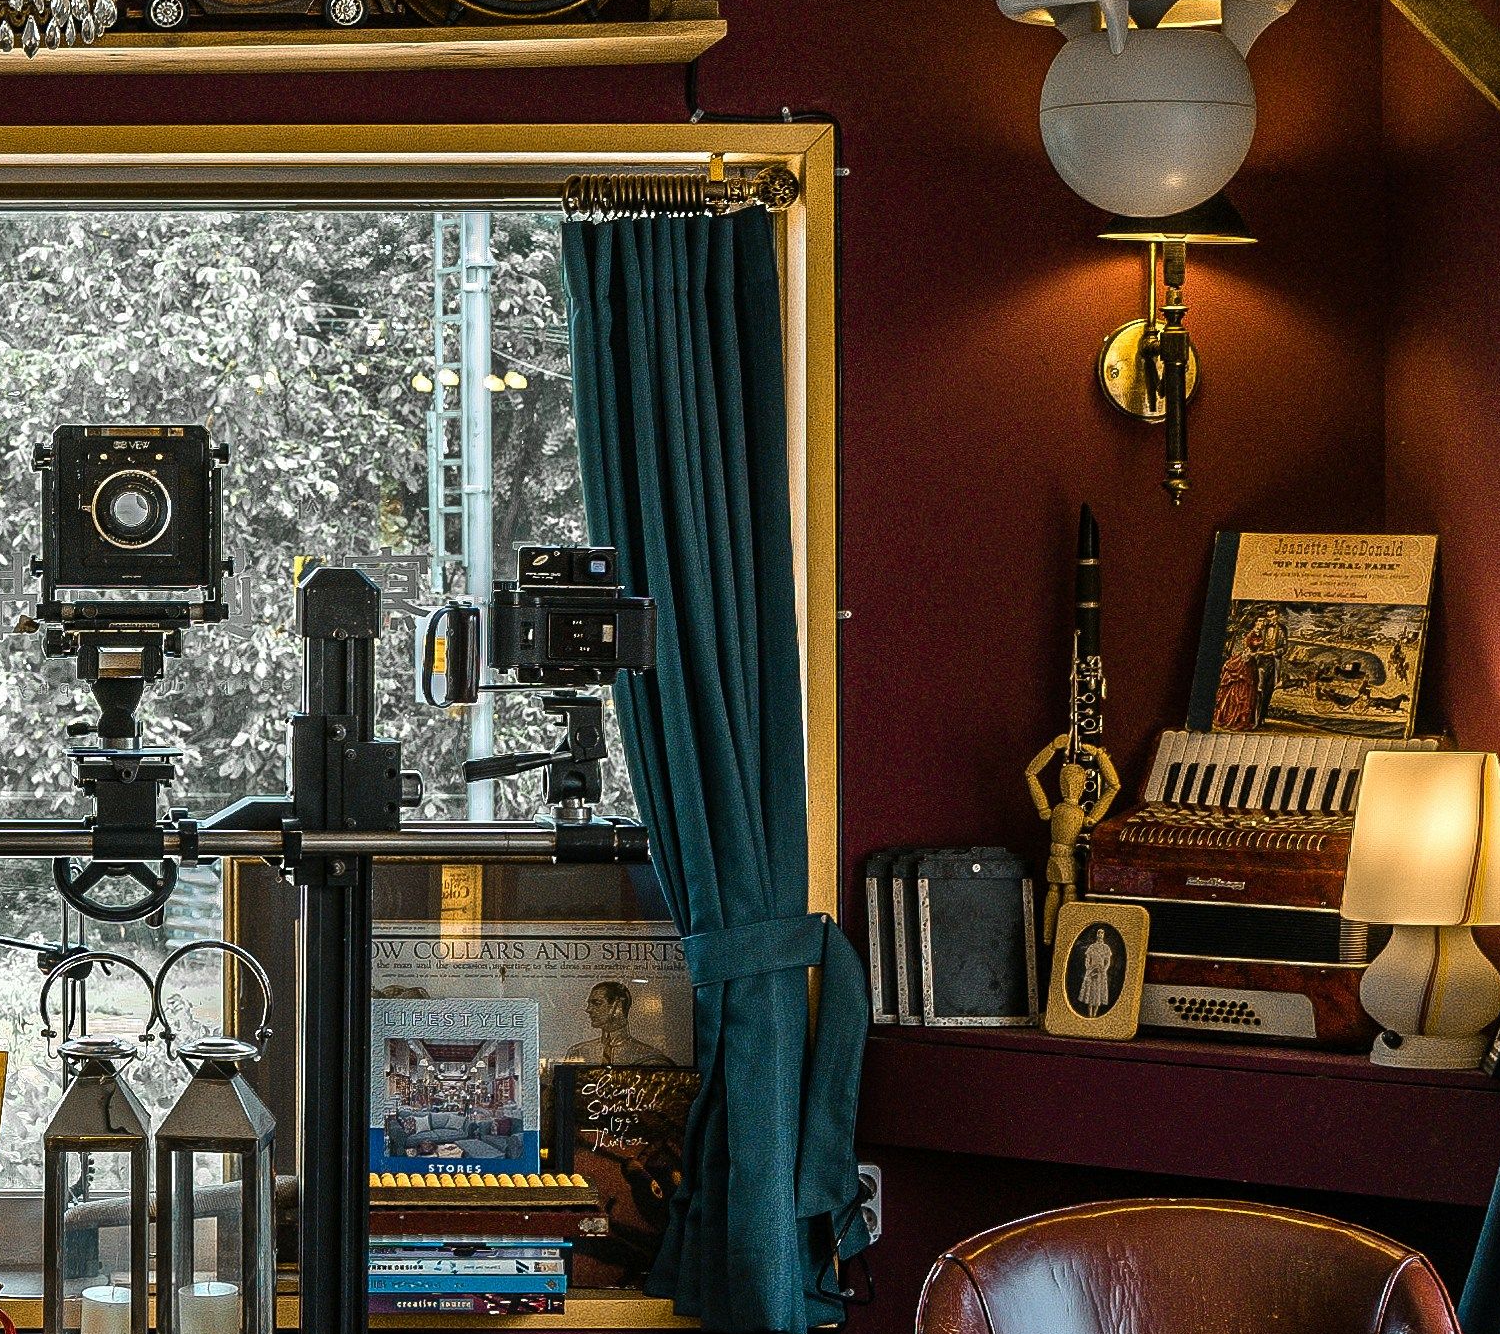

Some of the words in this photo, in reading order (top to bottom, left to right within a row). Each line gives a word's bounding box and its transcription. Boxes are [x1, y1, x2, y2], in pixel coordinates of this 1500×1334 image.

[1274, 538, 1328, 555] Jeanette
[1332, 539, 1404, 557] MacDonald
[1311, 561, 1362, 570] CENTRAL
[371, 941, 404, 959] OW
[413, 941, 525, 960] COLLARS
[535, 942, 591, 960] AND
[602, 942, 686, 961] SHIRTS
[377, 960, 390, 969] the
[416, 960, 431, 968] and
[436, 960, 448, 969] the
[533, 962, 542, 970] to
[545, 961, 558, 970] the
[384, 1012, 525, 1028] LIFESTYLE
[428, 1164, 482, 1174] STORES
[396, 1299, 438, 1308] creative
[440, 1299, 472, 1309] source
